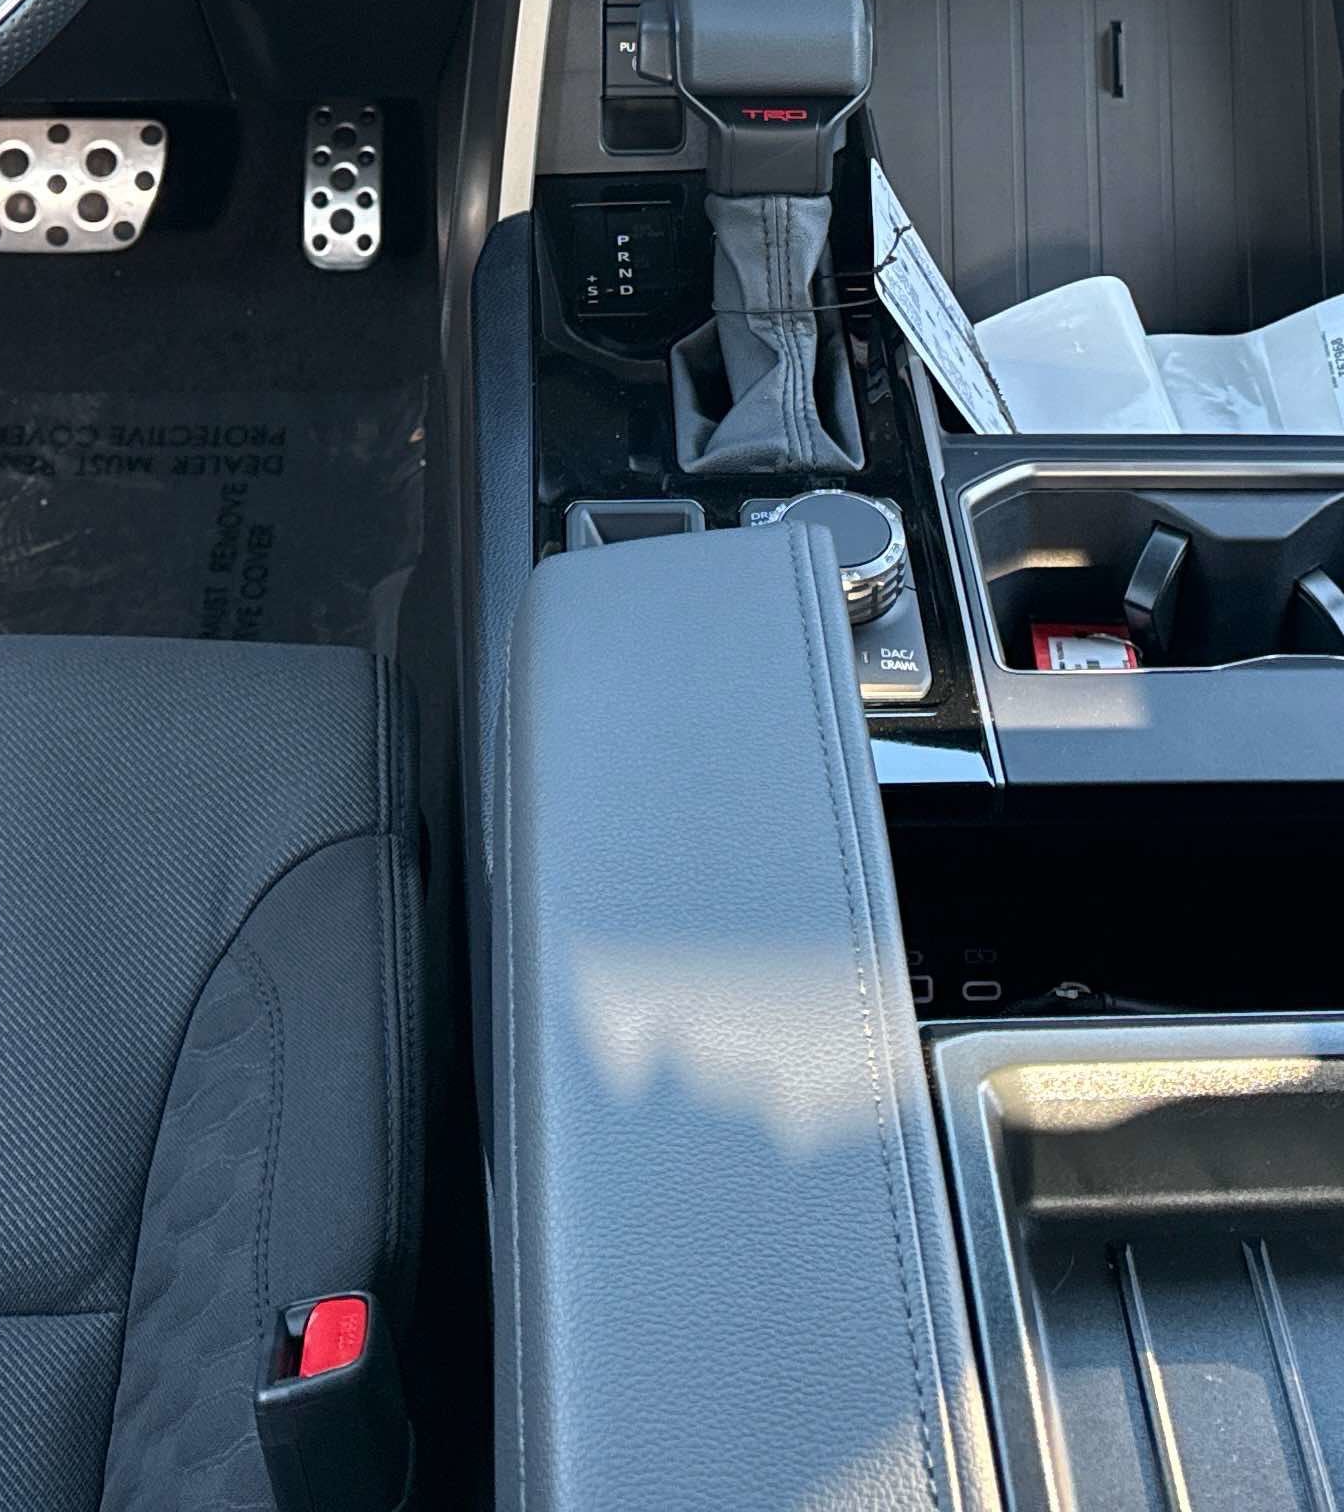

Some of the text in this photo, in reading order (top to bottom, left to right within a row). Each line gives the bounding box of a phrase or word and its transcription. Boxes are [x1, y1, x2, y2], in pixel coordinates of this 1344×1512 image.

[741, 108, 808, 122] TRD
[617, 235, 630, 246] P
[617, 251, 631, 262] R
[619, 268, 633, 278] N
[587, 286, 599, 297] S
[620, 285, 634, 296] D
[109, 424, 287, 448] PROTECTIVE
[74, 453, 153, 477] MUST
[170, 454, 285, 478] DEALER
[880, 648, 914, 660] DAC/
[880, 659, 919, 672] CRAWL
